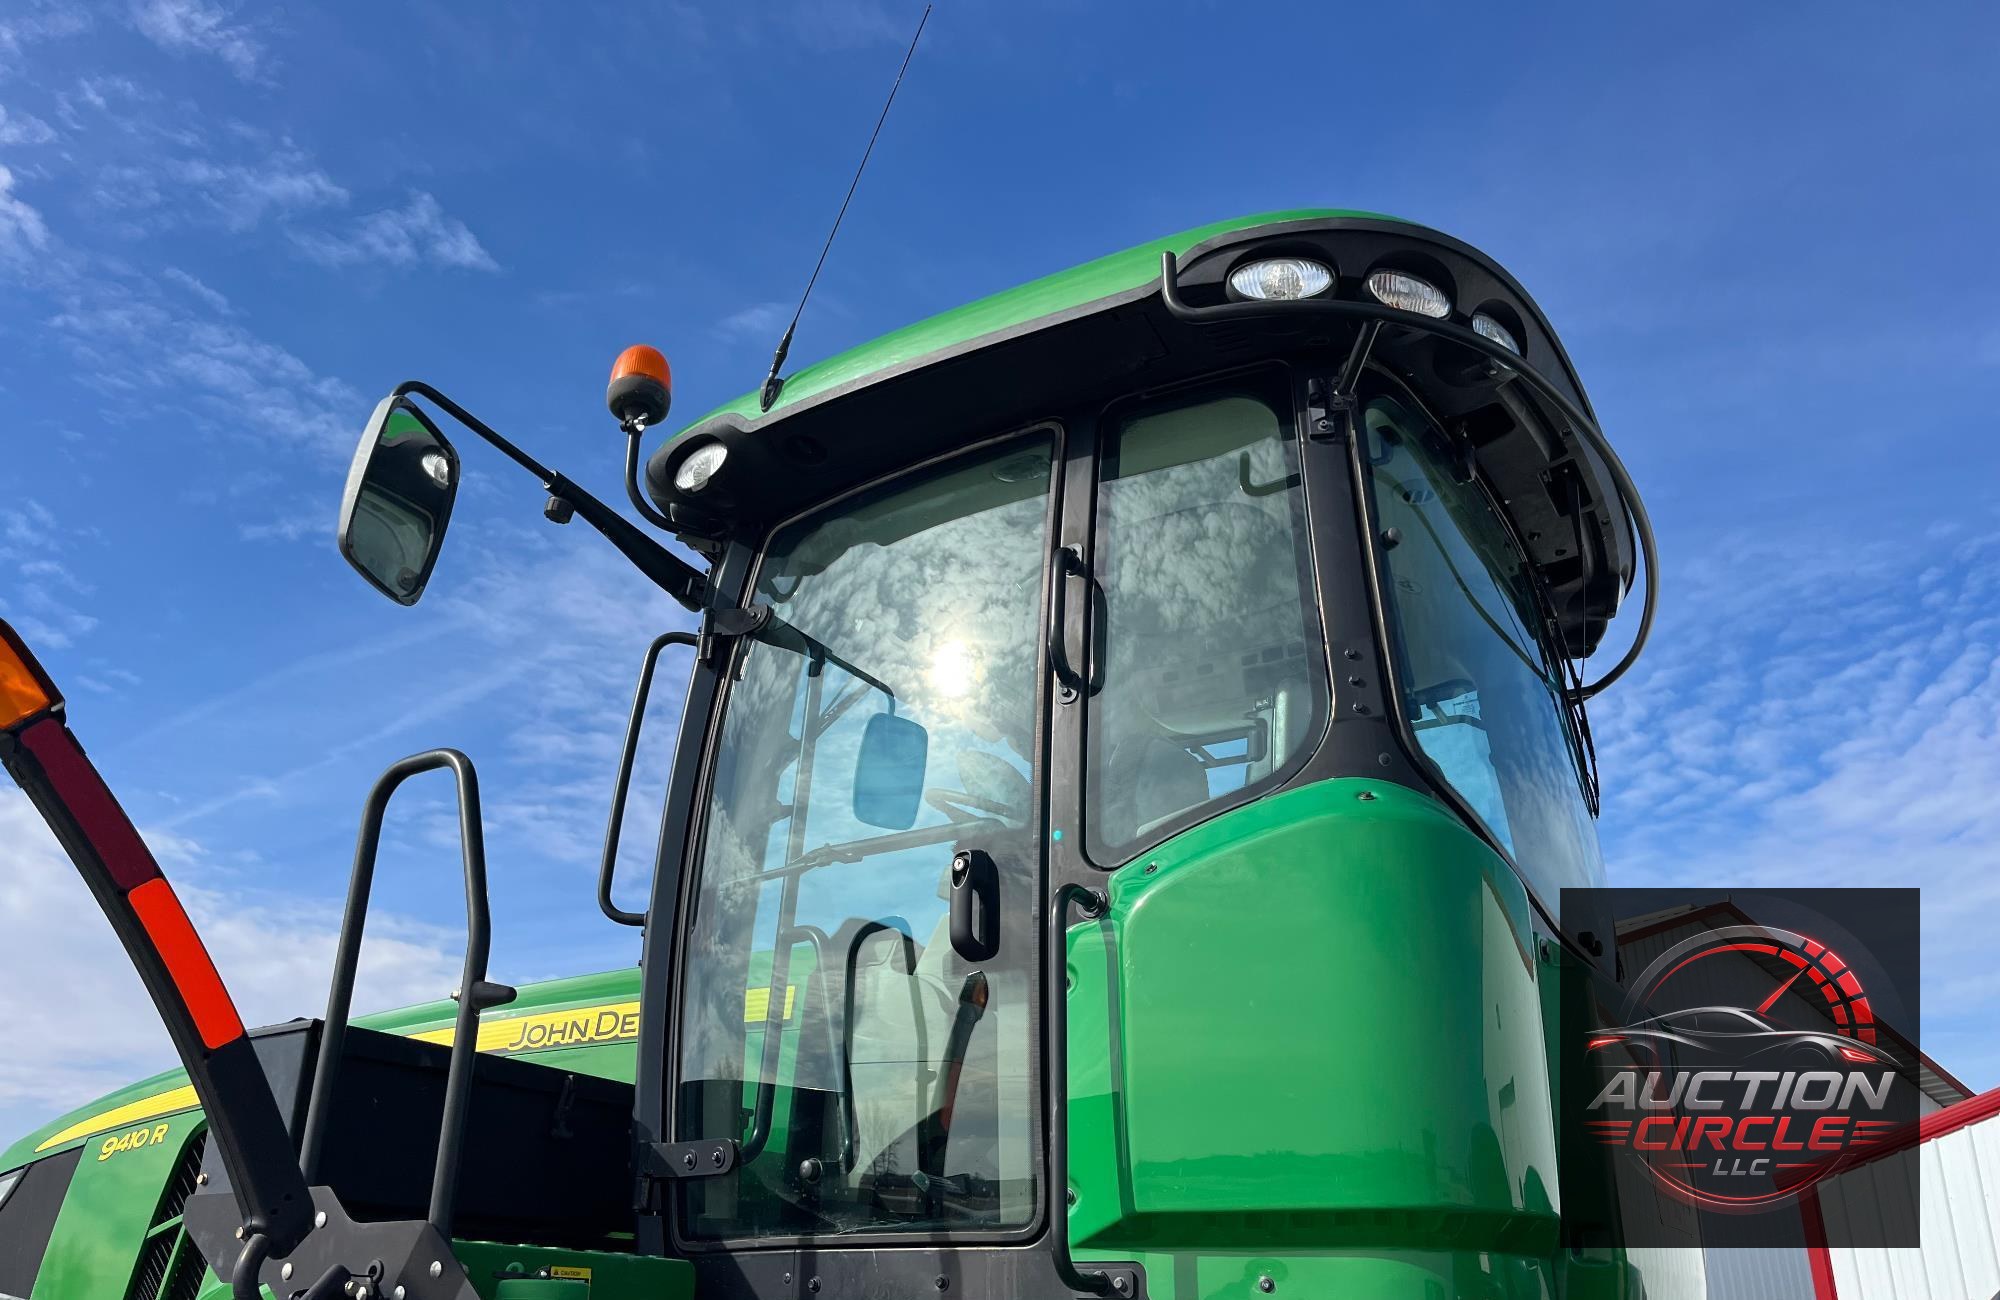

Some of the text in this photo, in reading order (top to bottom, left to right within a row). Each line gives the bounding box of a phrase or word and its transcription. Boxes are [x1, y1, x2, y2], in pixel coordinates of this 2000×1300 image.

[508, 1018, 590, 1048] JOHN
[97, 1123, 169, 1162] 9410 R
